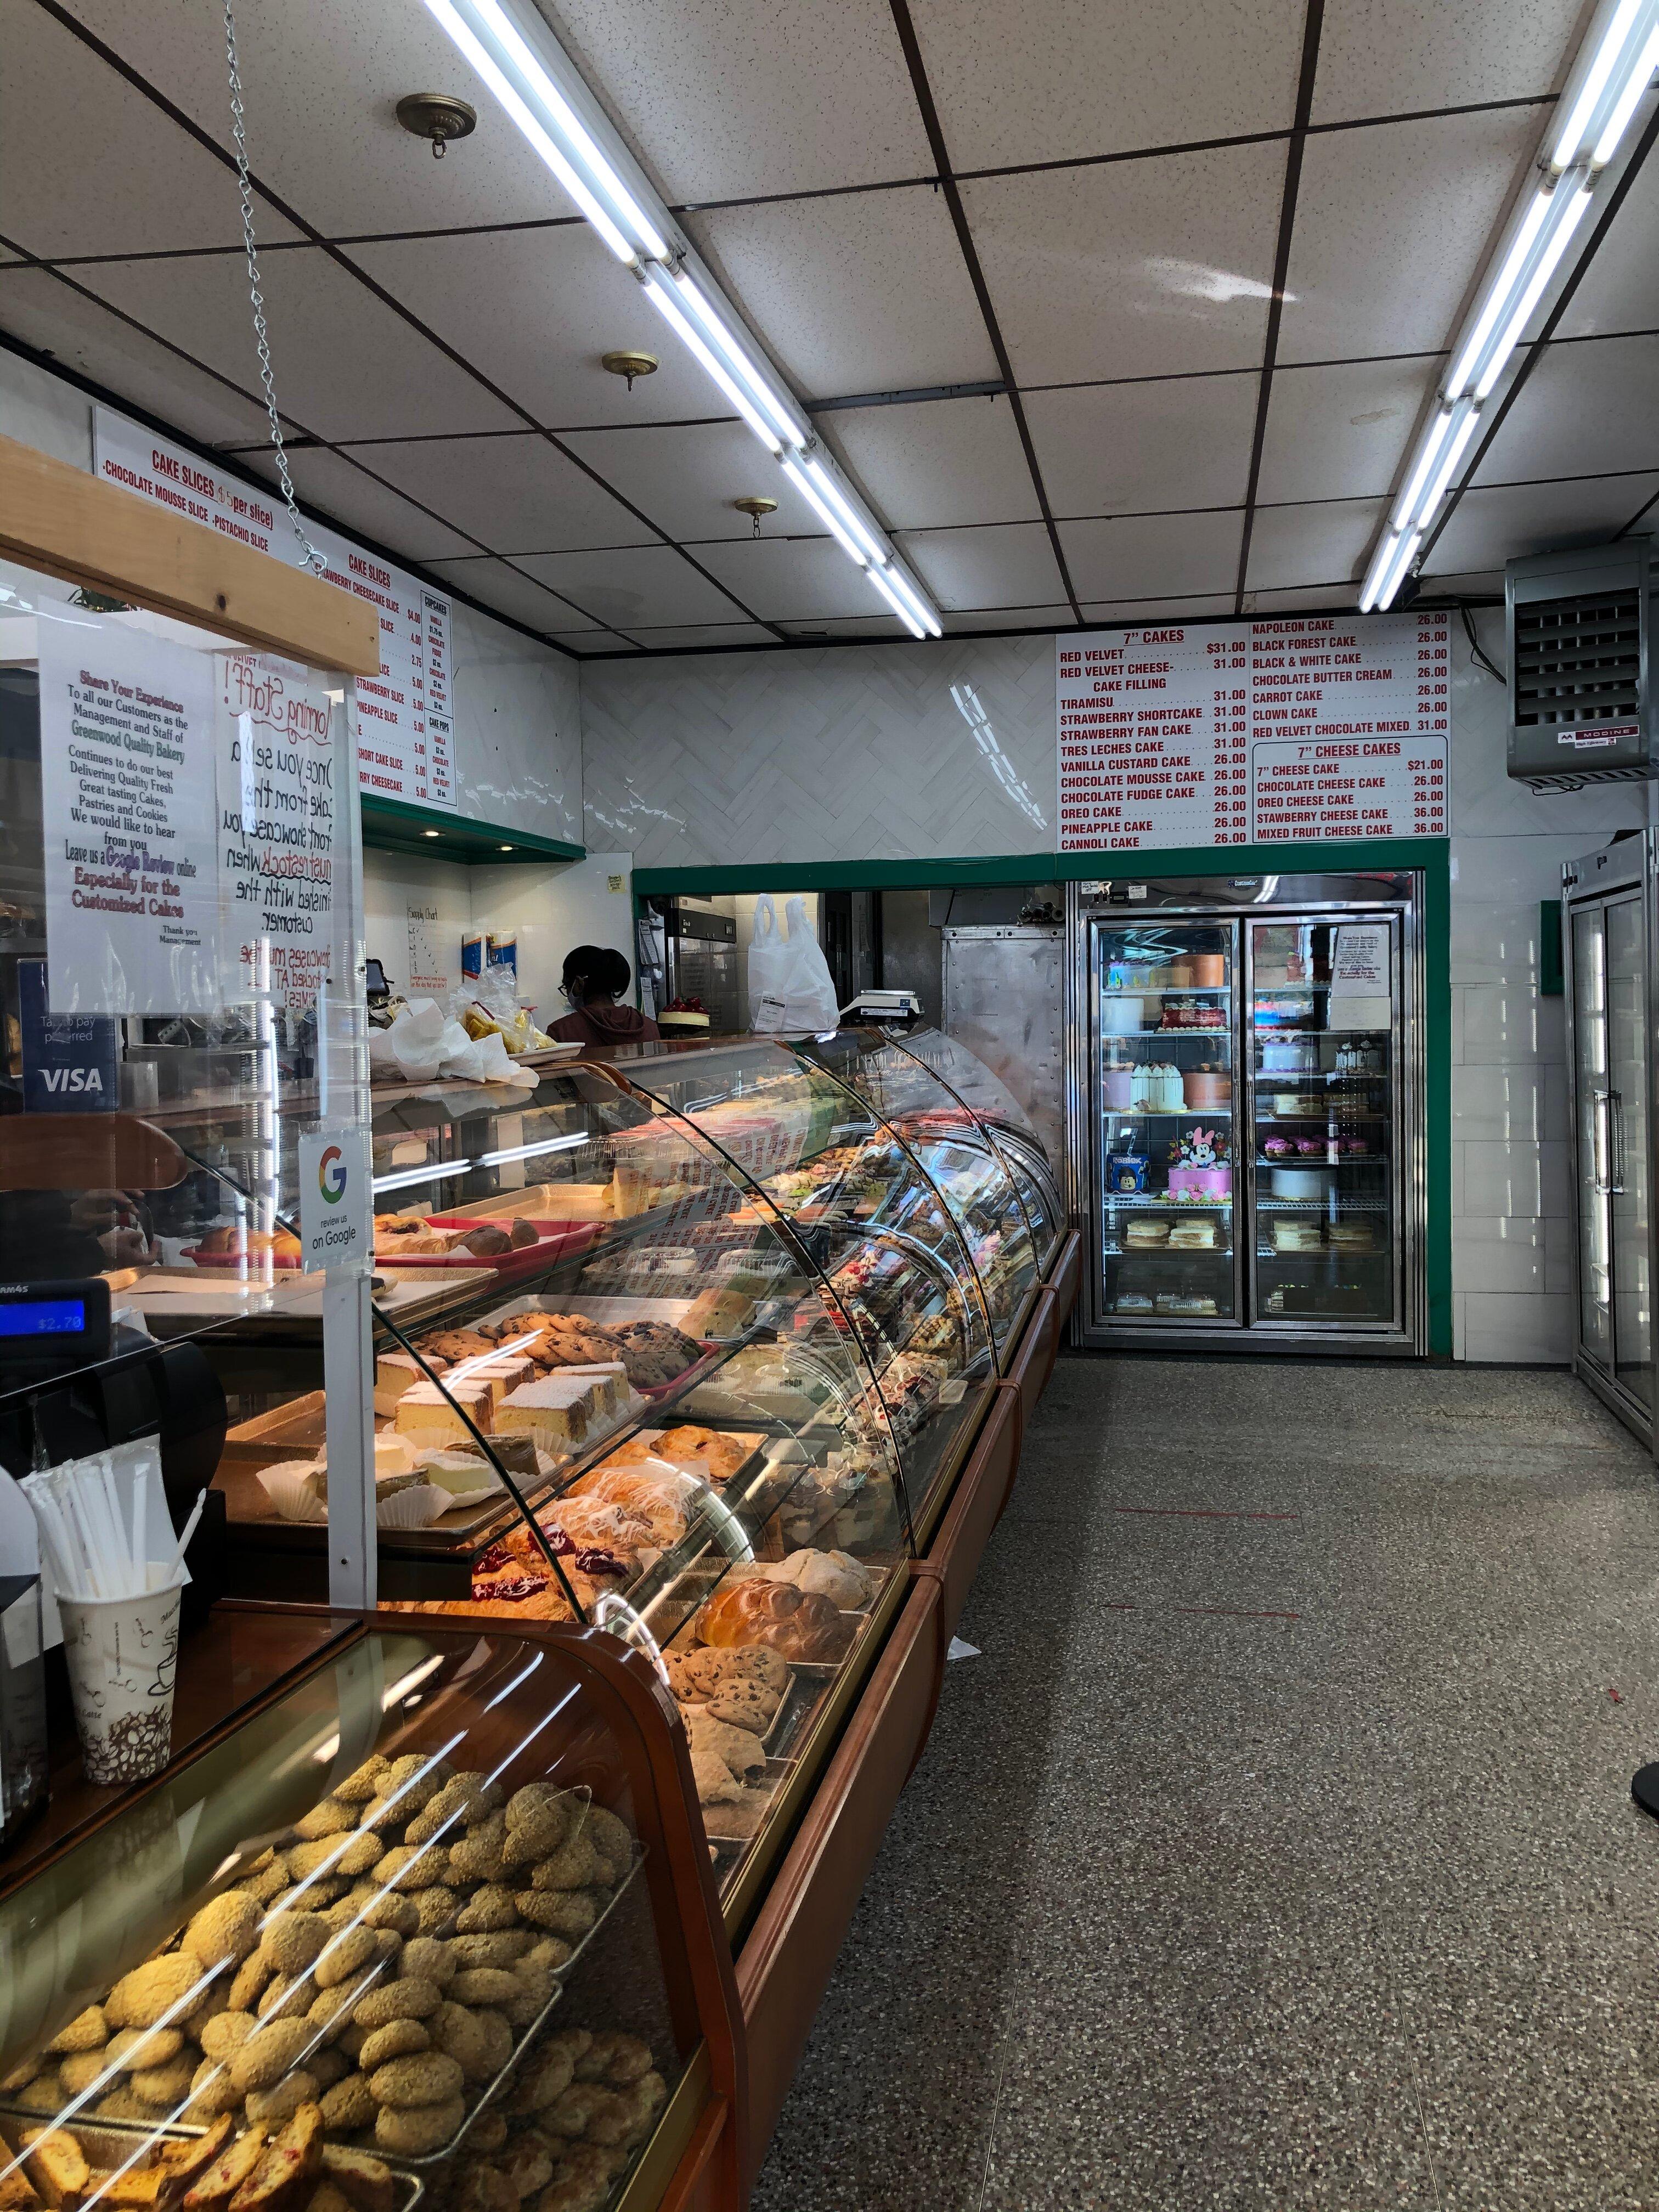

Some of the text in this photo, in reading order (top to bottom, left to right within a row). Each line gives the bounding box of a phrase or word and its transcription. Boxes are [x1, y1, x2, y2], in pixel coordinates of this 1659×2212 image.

[152, 450, 179, 480] CAKE
[182, 466, 215, 497] SLICES
[250, 504, 273, 531] slice)
[155, 484, 186, 511] MOUSSE
[188, 500, 208, 522] SLICE
[251, 533, 268, 552] SLICE
[348, 554, 391, 588] CAKE SLICES
[353, 581, 421, 624] CHEESECAKE SLICE $4.00
[425, 596, 447, 615] CUPCAKES
[380, 618, 421, 646] SLICE 4.00
[1252, 619, 1334, 635] NAPOLEON CAKE
[1143, 629, 1184, 644] CAKES
[1252, 636, 1356, 652] BLACK FOREST CAKE
[1060, 641, 1246, 663] RED VELVET $31.00
[1252, 653, 1362, 669] BLACK & WHITE CAKE
[1060, 662, 1174, 679] RED VELVET CHEESE-
[1252, 669, 1392, 686] CHOCOLATE BUTTER CREAM
[1093, 678, 1166, 692] CAKE FILLING
[357, 676, 424, 712] STRAWBERRY SLICE 5.00
[1252, 690, 1323, 704] CARROT CAKE
[67, 684, 188, 730] To all our Customers as the
[1060, 697, 1114, 710] TIRAMISU
[74, 702, 183, 743] Management and Staff of
[384, 709, 398, 724] SLICE
[1060, 708, 1203, 726] STRAWBERRY SHORTCAKE
[1253, 708, 1317, 721] CLOWN CAKE
[430, 716, 449, 732] CAKE POPS
[1060, 724, 1191, 741] STRAWBERRY FAN CAKE
[1253, 721, 1409, 738] RED VELVET CHOCOLATE MIXED
[1583, 729, 1630, 737] MODINE
[72, 719, 185, 765] Greenwood Quality Bakery
[1060, 741, 1164, 757] TRES LECHES CAKE
[1316, 744, 1359, 758] CHEESE
[1363, 742, 1401, 755] CAKES
[69, 744, 173, 780] Continues to do our best
[375, 752, 388, 766] CAKE
[390, 757, 403, 770] SLICE
[415, 764, 426, 777] 5.00
[1060, 756, 1190, 772] VANILLA CUSTARD CAKE
[1272, 765, 1310, 776] CHEESE
[1313, 763, 1340, 775] CAKE
[1408, 759, 1443, 772] $21.00
[70, 760, 173, 794] Delivering Quality Fresh
[1061, 771, 1205, 788] CHOCOLATE MOUSSE CAKE
[1257, 777, 1385, 793] CHOCOLATE CHEESE CAKE
[371, 774, 426, 798] CHEESECAKE 5.00
[1061, 787, 1195, 804] CHOCOLATE FUDGE CAKE
[1257, 794, 1354, 808] OREO CHEESE CAKE
[1061, 806, 1122, 819] OREO CAKE
[1257, 809, 1388, 824] STAWBERRY CHEESE CAKE
[71, 808, 176, 838] We would like to hear
[1061, 821, 1153, 835] PINEAPPLE CAKE
[1257, 824, 1393, 839] MIXED FRUIT CHEESE CAKE
[1061, 837, 1139, 850] CANNOLI CAKE
[409, 907, 438, 923] Supply Chart
[77, 1017, 95, 1029] pay
[38, 1068, 103, 1092] VISA
[320, 1214, 347, 1228] review us
[313, 1226, 356, 1250] on Google
[38, 1317, 81, 1330] $2.70
